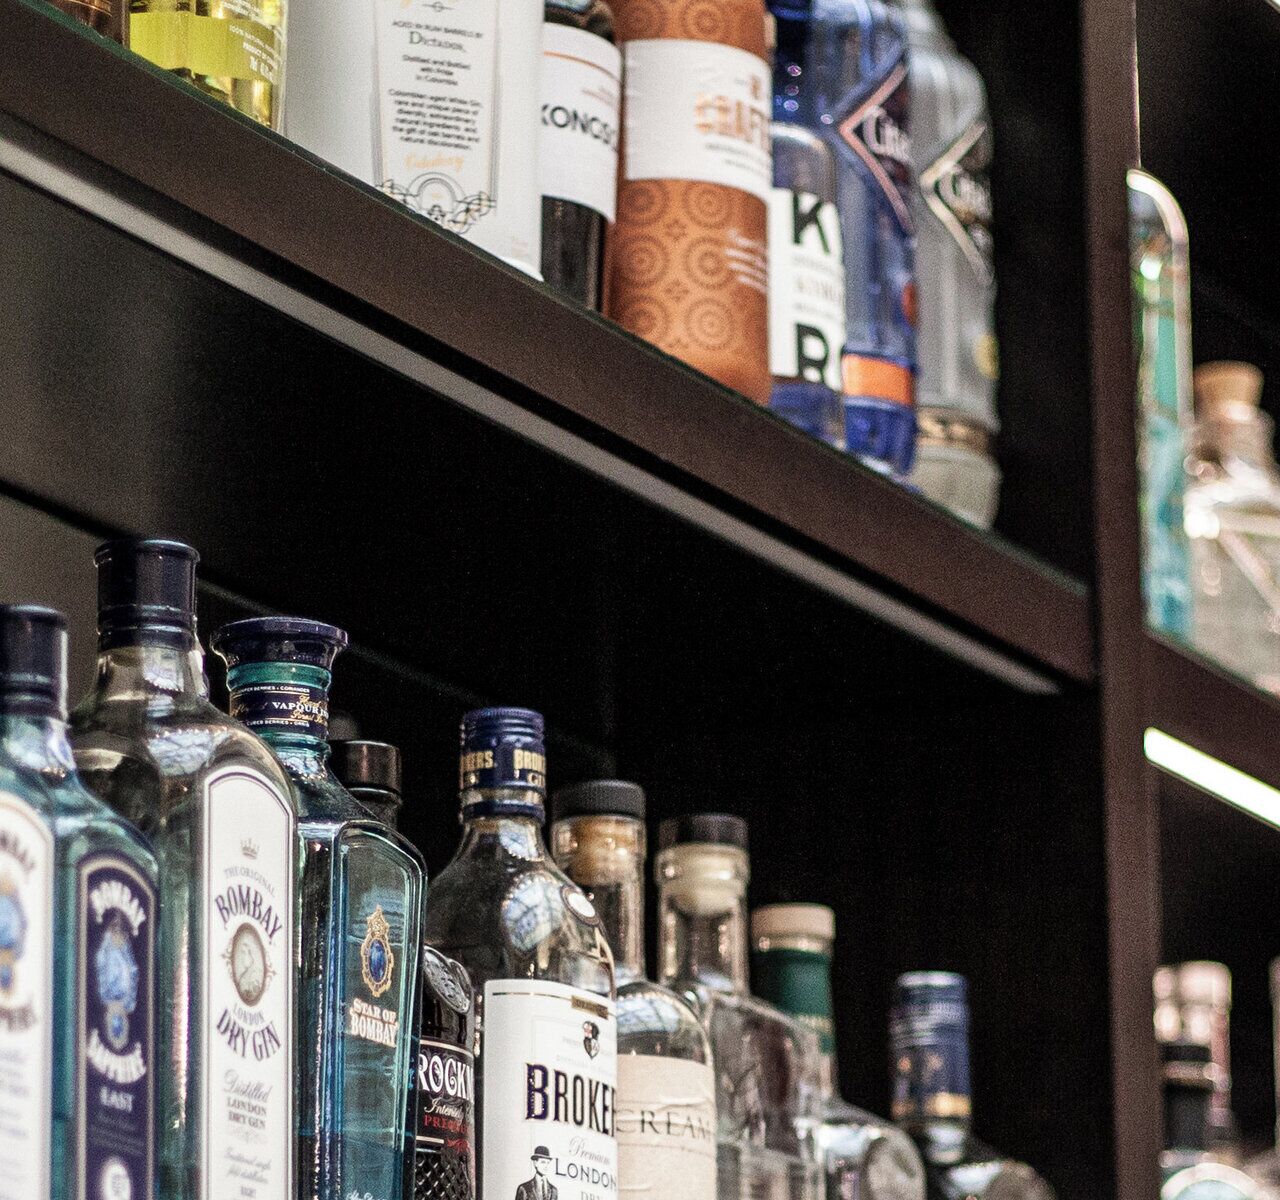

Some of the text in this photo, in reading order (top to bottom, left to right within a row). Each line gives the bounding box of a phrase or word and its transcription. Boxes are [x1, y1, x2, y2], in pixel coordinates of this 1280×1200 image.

[90, 879, 146, 937] BOMBAY
[215, 884, 283, 945] BOMBAY
[232, 1003, 265, 1025] LONDON
[353, 998, 397, 1022] STAR OF
[216, 1008, 281, 1062] DRY GIN
[350, 1009, 399, 1048] BOMBAY
[86, 1028, 147, 1084] SAPPHIRE
[100, 1086, 134, 1113] EAST
[224, 1069, 273, 1103] Distilled
[227, 1097, 267, 1116] LONDON
[228, 1111, 266, 1129] DRY GIN
[569, 1136, 610, 1166] Premium
[555, 1158, 617, 1191] LONDON
